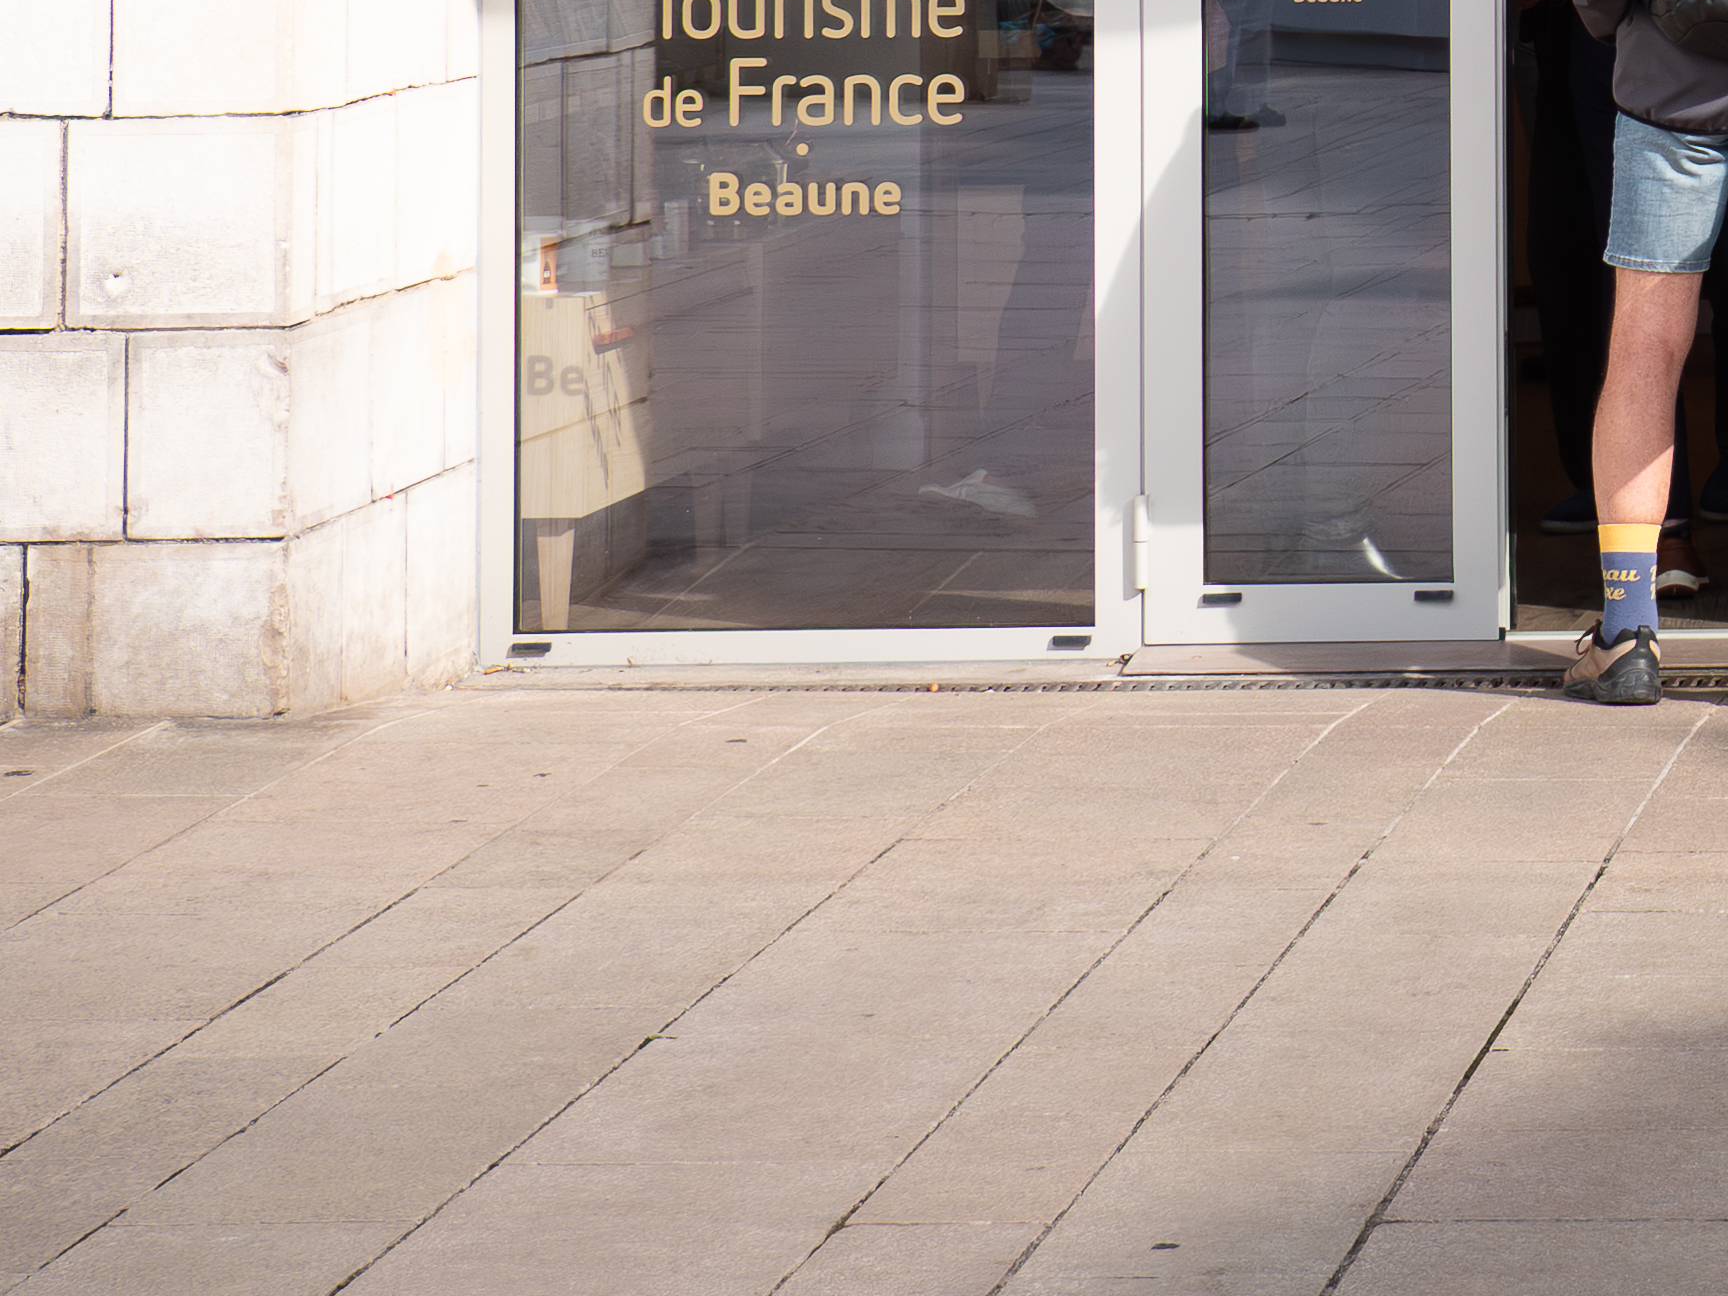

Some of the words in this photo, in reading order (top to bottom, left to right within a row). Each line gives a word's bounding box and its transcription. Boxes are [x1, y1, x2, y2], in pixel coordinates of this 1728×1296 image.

[643, 77, 703, 128] de
[728, 57, 966, 128] France
[708, 172, 902, 217] Beaune
